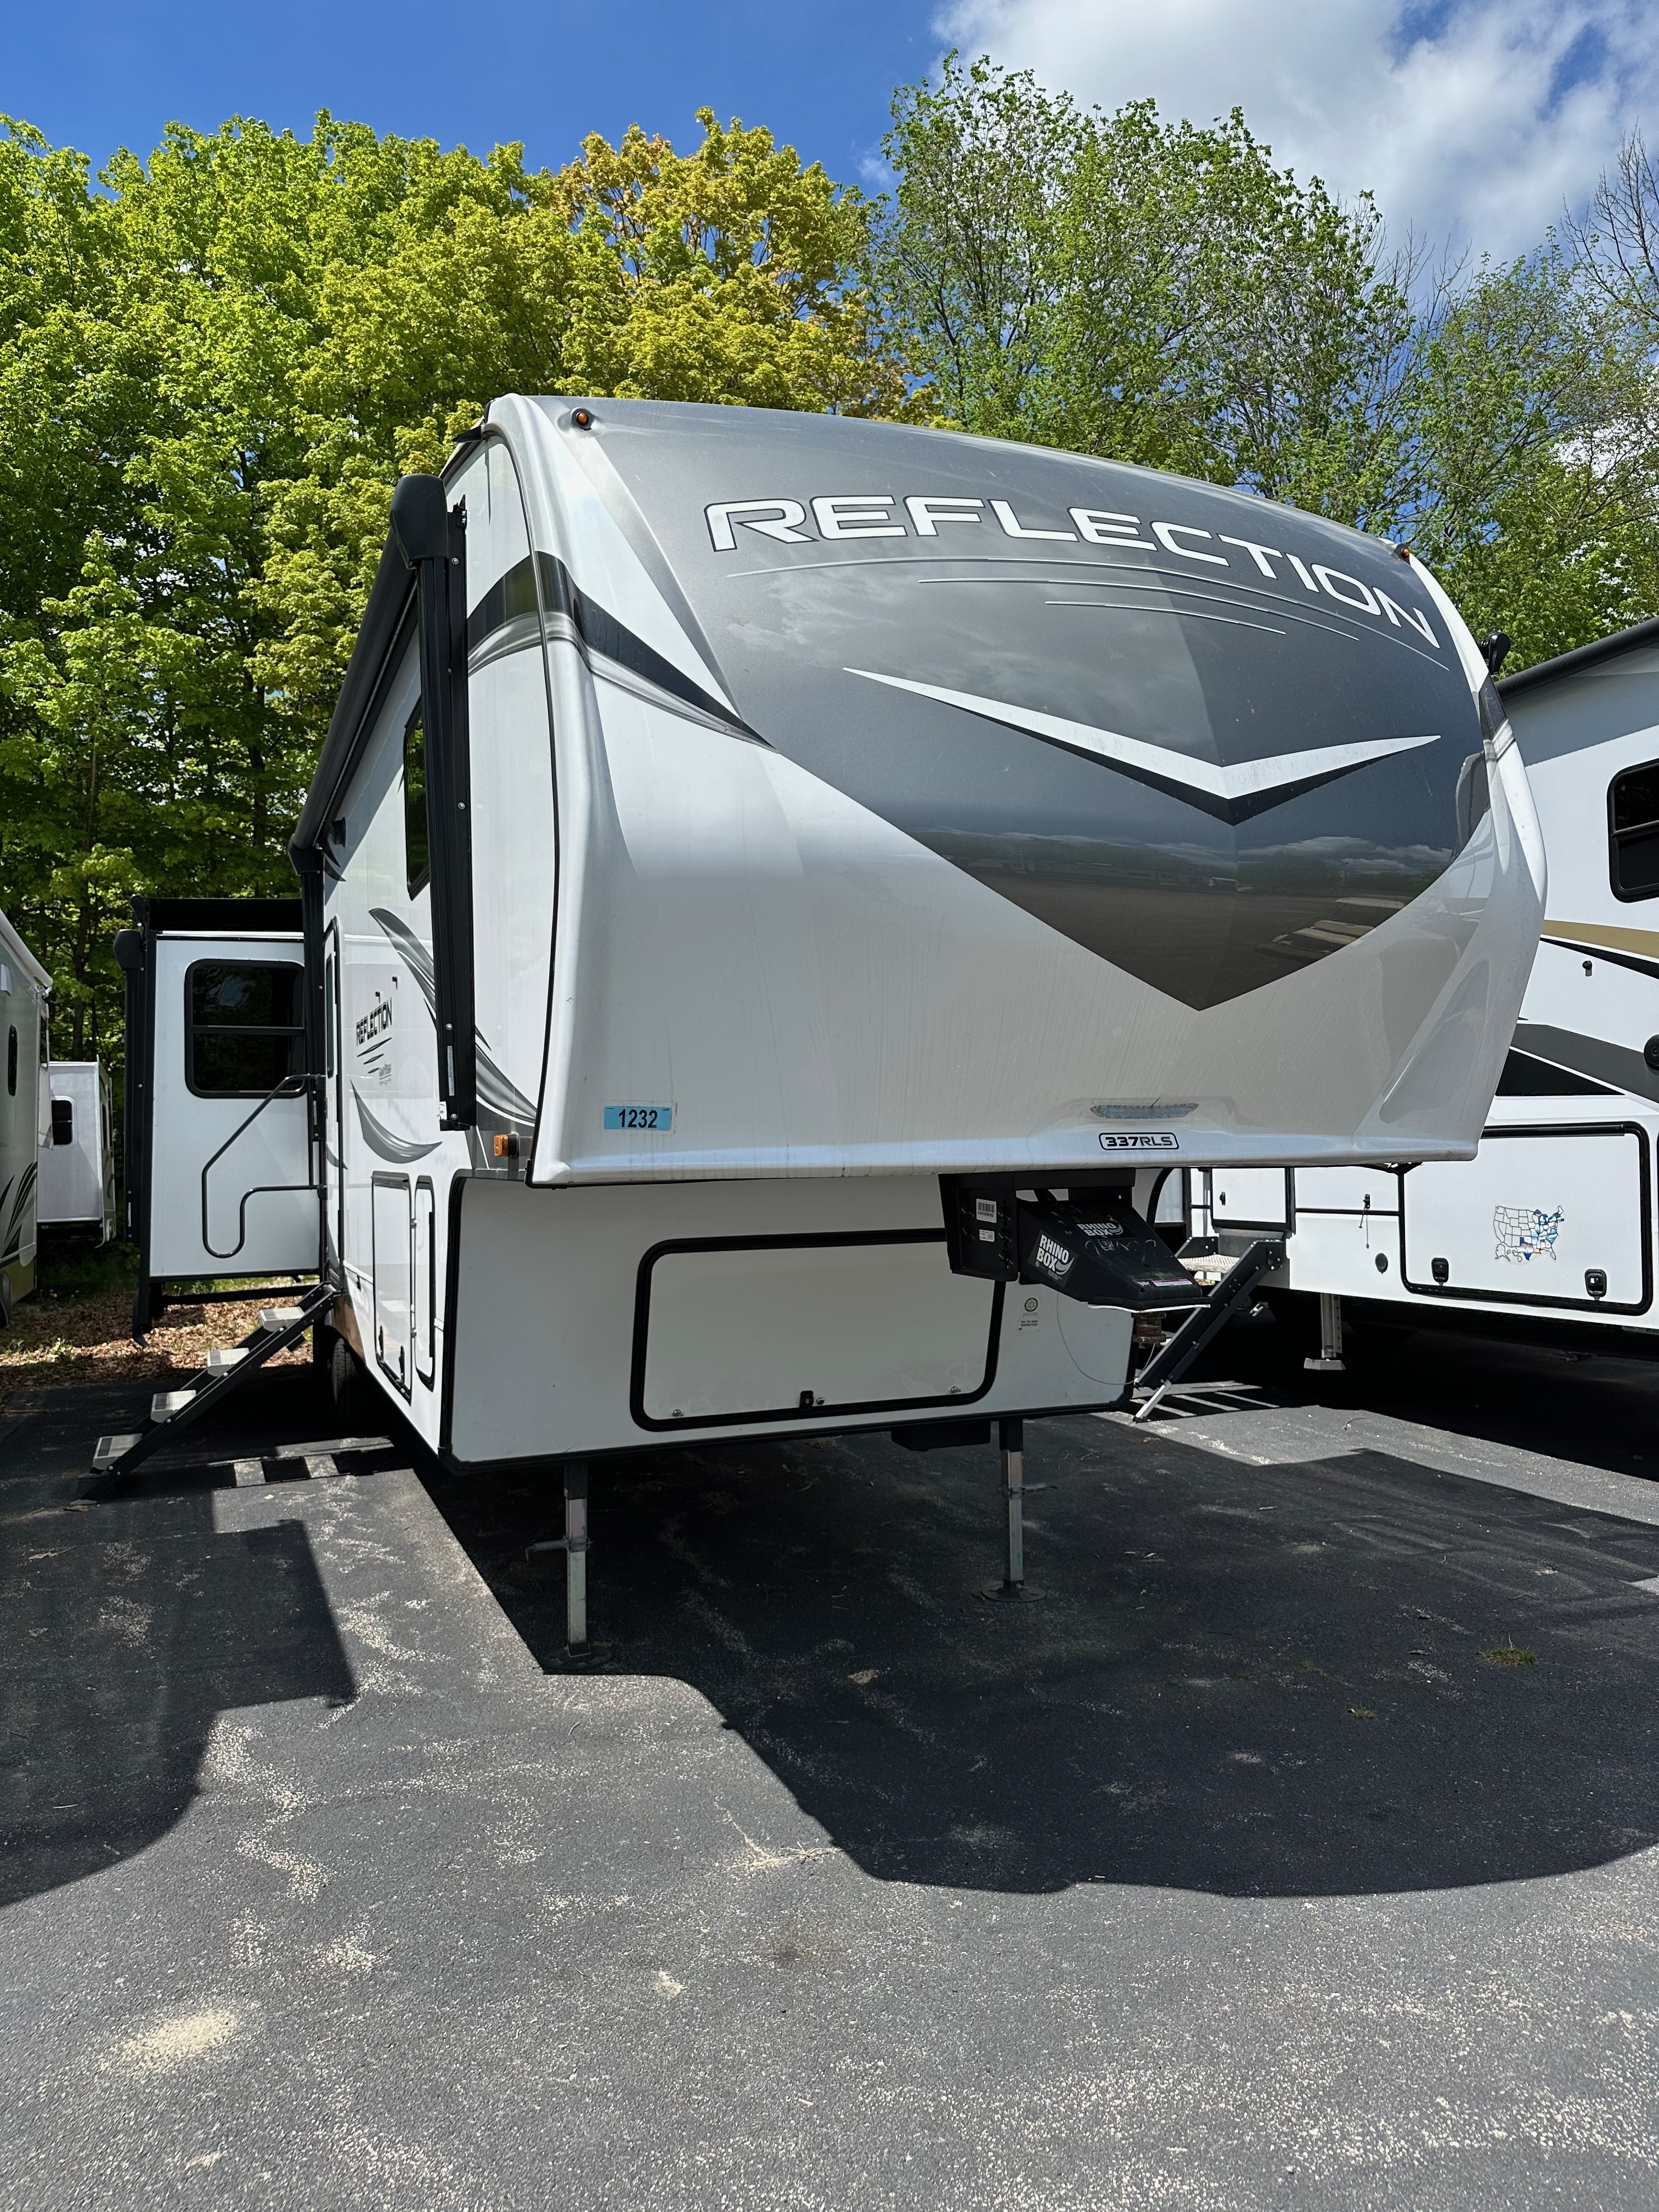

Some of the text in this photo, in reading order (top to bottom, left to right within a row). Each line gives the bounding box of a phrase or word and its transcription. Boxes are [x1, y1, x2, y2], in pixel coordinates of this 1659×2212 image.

[704, 494, 1443, 650] REFLECTION
[356, 997, 392, 1046] REFLECTION
[619, 1109, 658, 1128] 1232
[1105, 1136, 1173, 1147] 337RLS
[1036, 1247, 1057, 1272] BOX
[1040, 1234, 1069, 1263] RHINO
